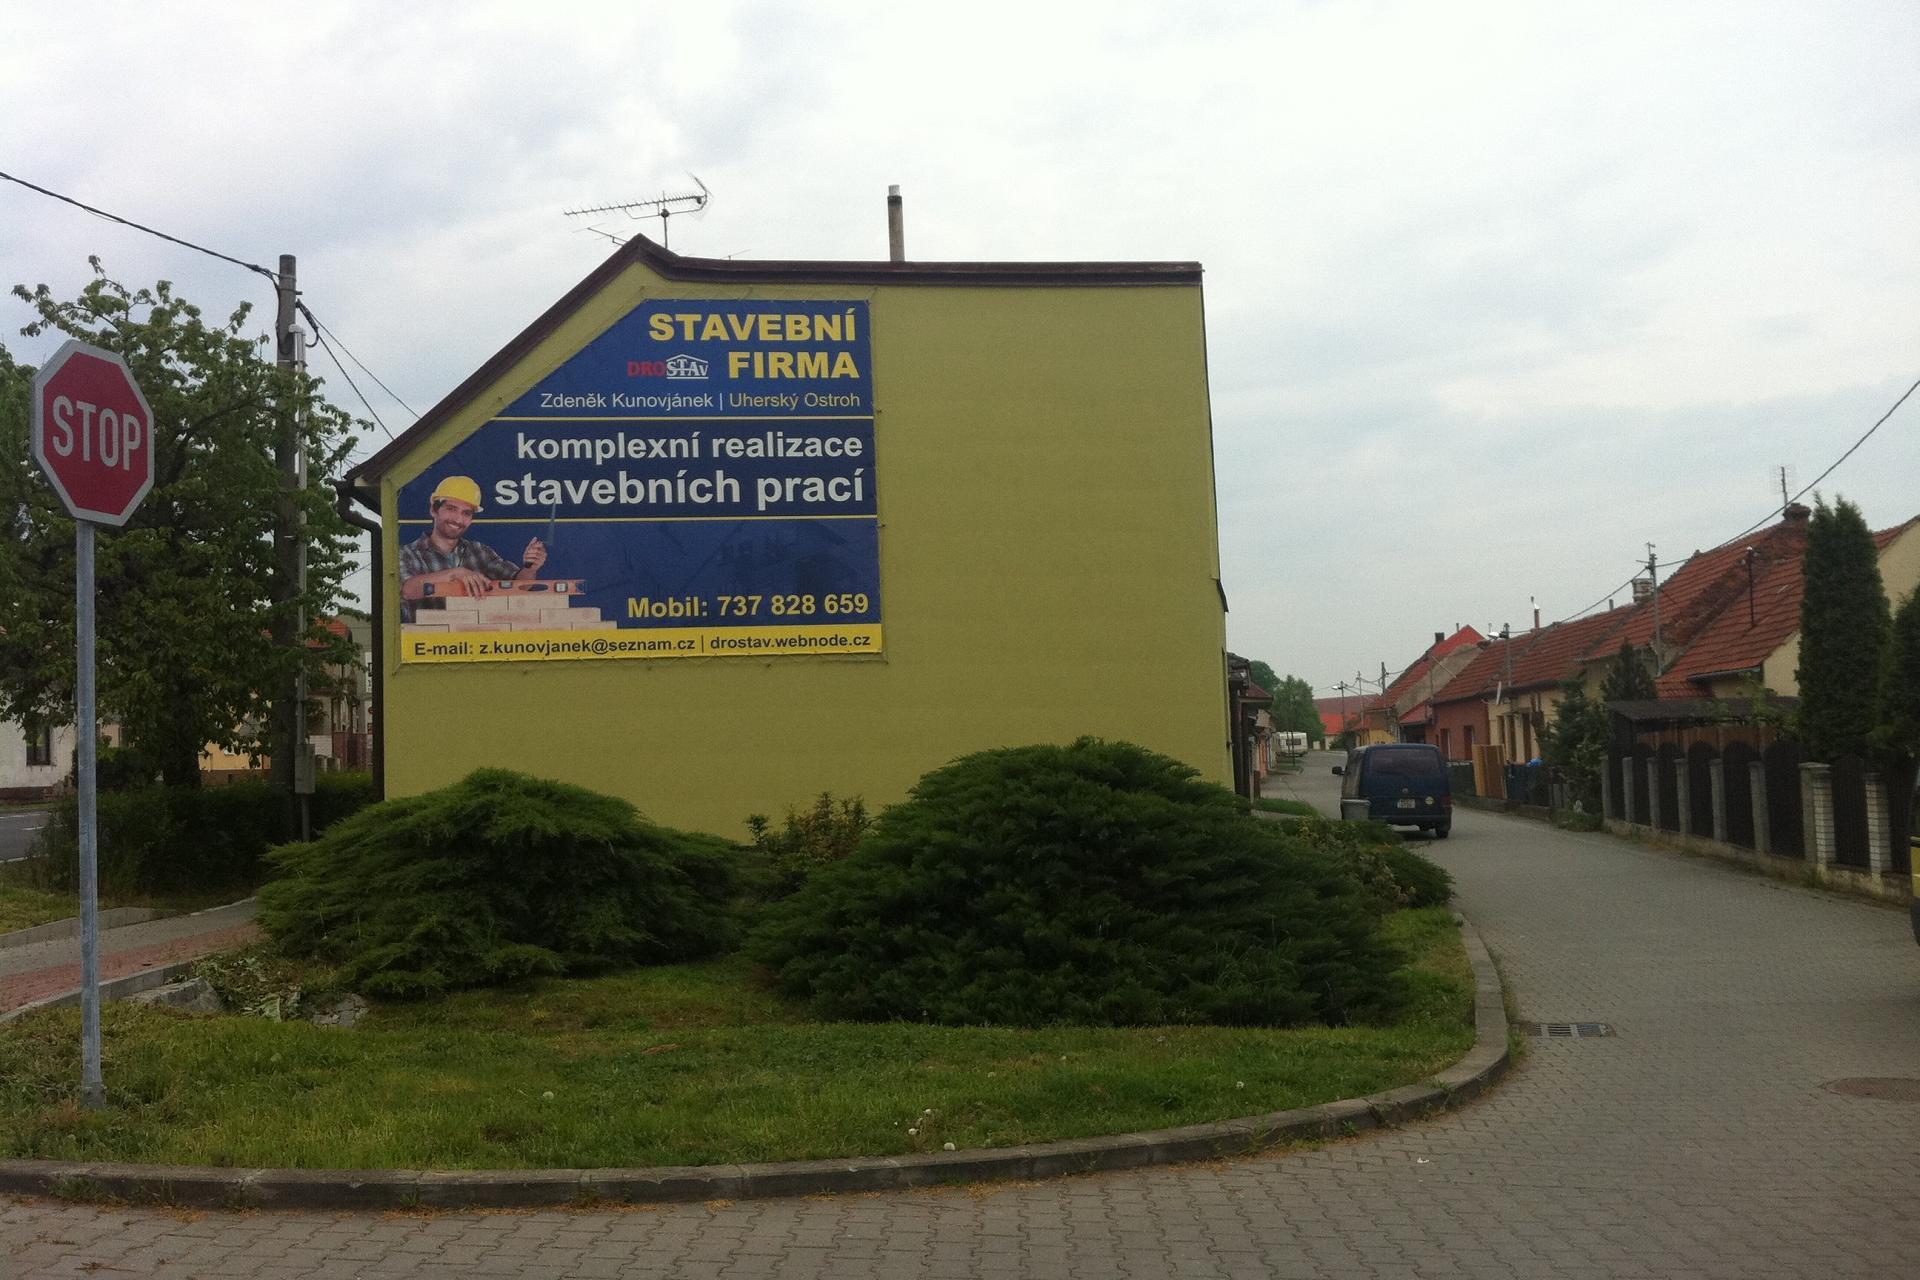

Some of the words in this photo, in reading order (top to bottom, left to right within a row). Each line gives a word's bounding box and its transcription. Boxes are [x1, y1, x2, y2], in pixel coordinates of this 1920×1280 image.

[648, 308, 856, 341] STAVEBNÍ
[728, 351, 860, 379] FIRMA
[541, 392, 606, 408] Zdeněk
[612, 392, 714, 411] Kunovjánek
[729, 392, 799, 411] Uherský
[804, 392, 861, 408] Ostroh
[52, 395, 141, 471] STOP
[517, 431, 700, 465] komplexní
[711, 431, 863, 458] realizace
[494, 469, 740, 506] stavebních
[757, 469, 864, 511] prací
[627, 597, 708, 618] Mobil:
[717, 595, 762, 616] 737
[771, 595, 816, 615] 828
[824, 593, 869, 614] 659
[414, 642, 474, 656] E-mail:
[479, 635, 696, 655] z.kunovjanek@seznam.cz
[710, 633, 871, 650] drostav.webnode.cz
